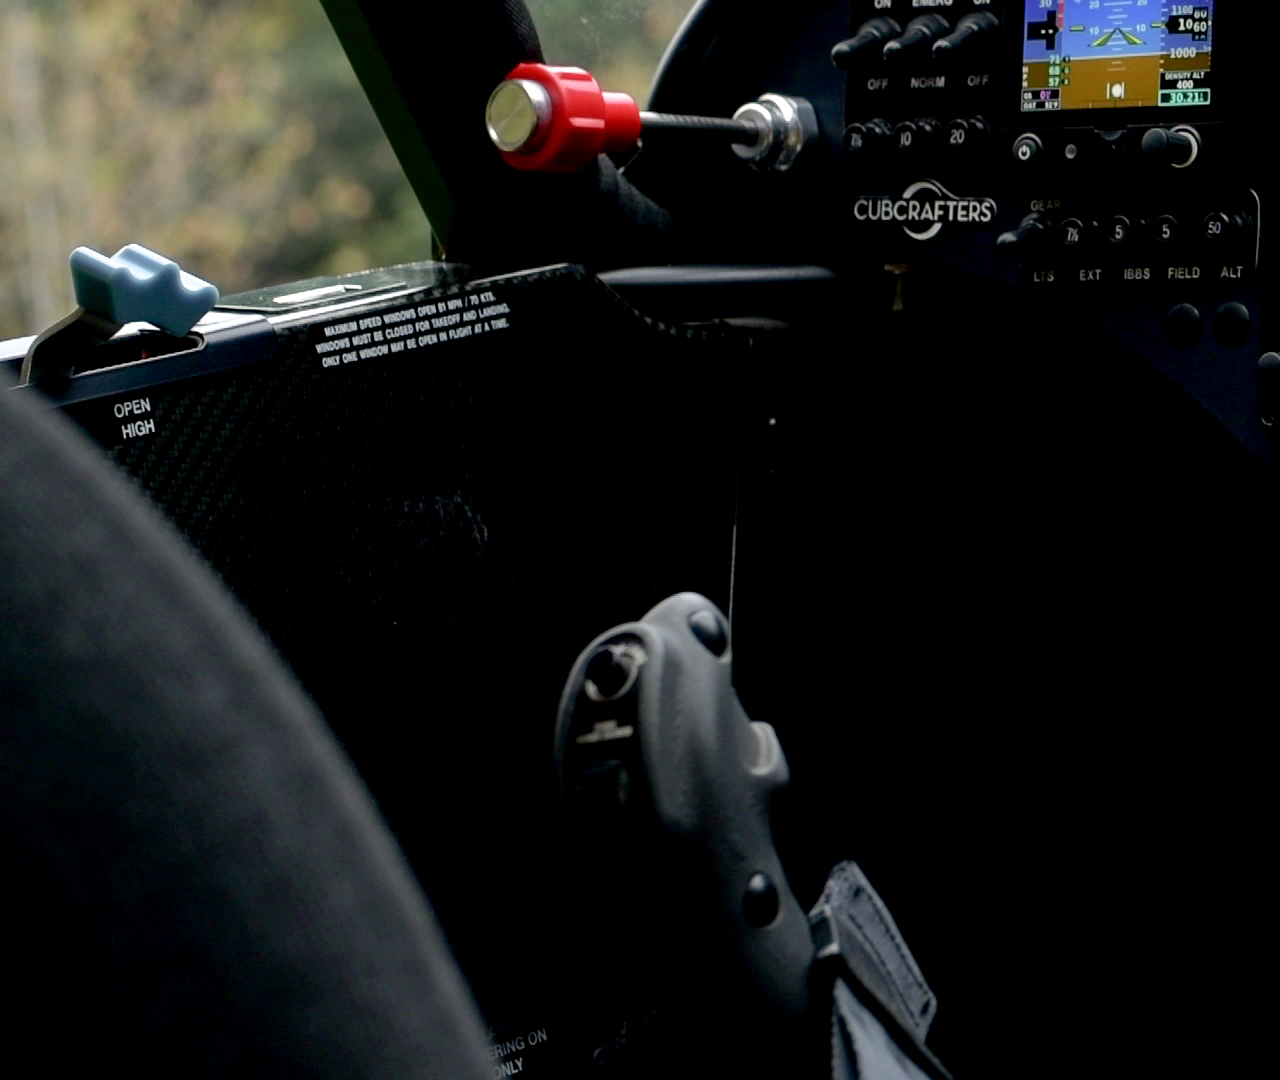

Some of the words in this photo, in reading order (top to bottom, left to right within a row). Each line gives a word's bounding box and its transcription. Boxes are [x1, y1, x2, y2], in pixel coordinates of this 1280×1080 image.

[910, 75, 946, 90] NORM
[853, 200, 992, 222] CUBCRAFTERS
[1031, 199, 1060, 211] GEAR
[1033, 270, 1054, 282] LTS
[1079, 269, 1102, 281] EXT
[1124, 267, 1150, 280] IBBS
[1168, 266, 1200, 279] FIELD
[1220, 266, 1243, 278] ALT
[324, 320, 358, 337] MAXIMUM
[359, 316, 382, 330] SPEED
[383, 308, 416, 324] WINDOWS
[417, 304, 437, 317] OPEN
[315, 338, 350, 354] WINDOWS
[352, 333, 371, 346] MUST
[373, 330, 384, 341] BE
[385, 323, 414, 339] CLOSED
[415, 320, 430, 333] FOR
[431, 313, 460, 328] TAKEOFF
[463, 310, 477, 322] AND
[322, 354, 340, 368] ONLY
[342, 351, 358, 363] ONE
[359, 344, 388, 359] WINDOW
[390, 340, 405, 353] MAY
[406, 338, 417, 349] BE
[418, 333, 438, 347] OPEN
[448, 325, 472, 340] FLIGHT
[113, 397, 151, 419] OPEN
[120, 417, 156, 439] HIGH
[528, 1028, 547, 1046] ON
